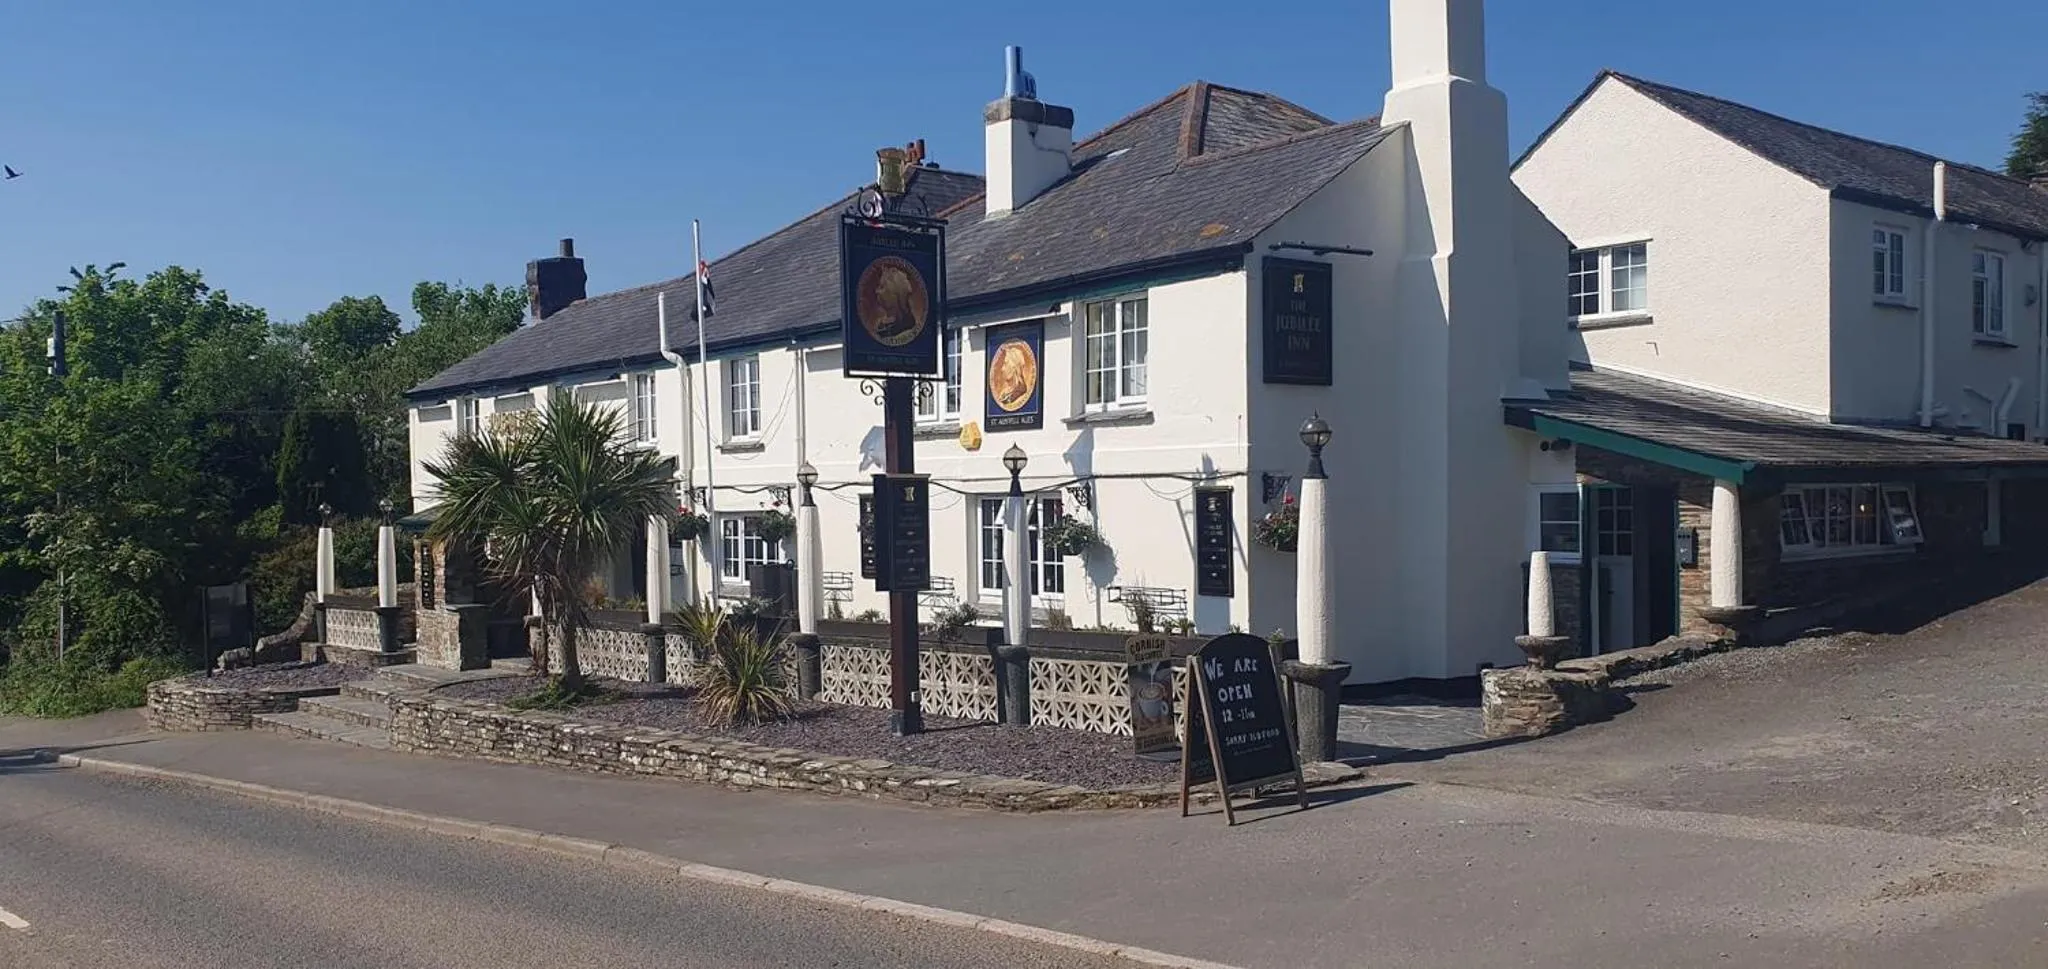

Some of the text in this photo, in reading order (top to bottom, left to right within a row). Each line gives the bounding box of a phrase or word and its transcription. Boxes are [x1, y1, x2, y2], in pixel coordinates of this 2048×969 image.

[1276, 314, 1321, 333] JUBILEE
[1288, 335, 1311, 352] INN
[1204, 656, 1257, 681] WE ARE
[1218, 683, 1253, 703] OPEN
[1222, 708, 1234, 723] 12
